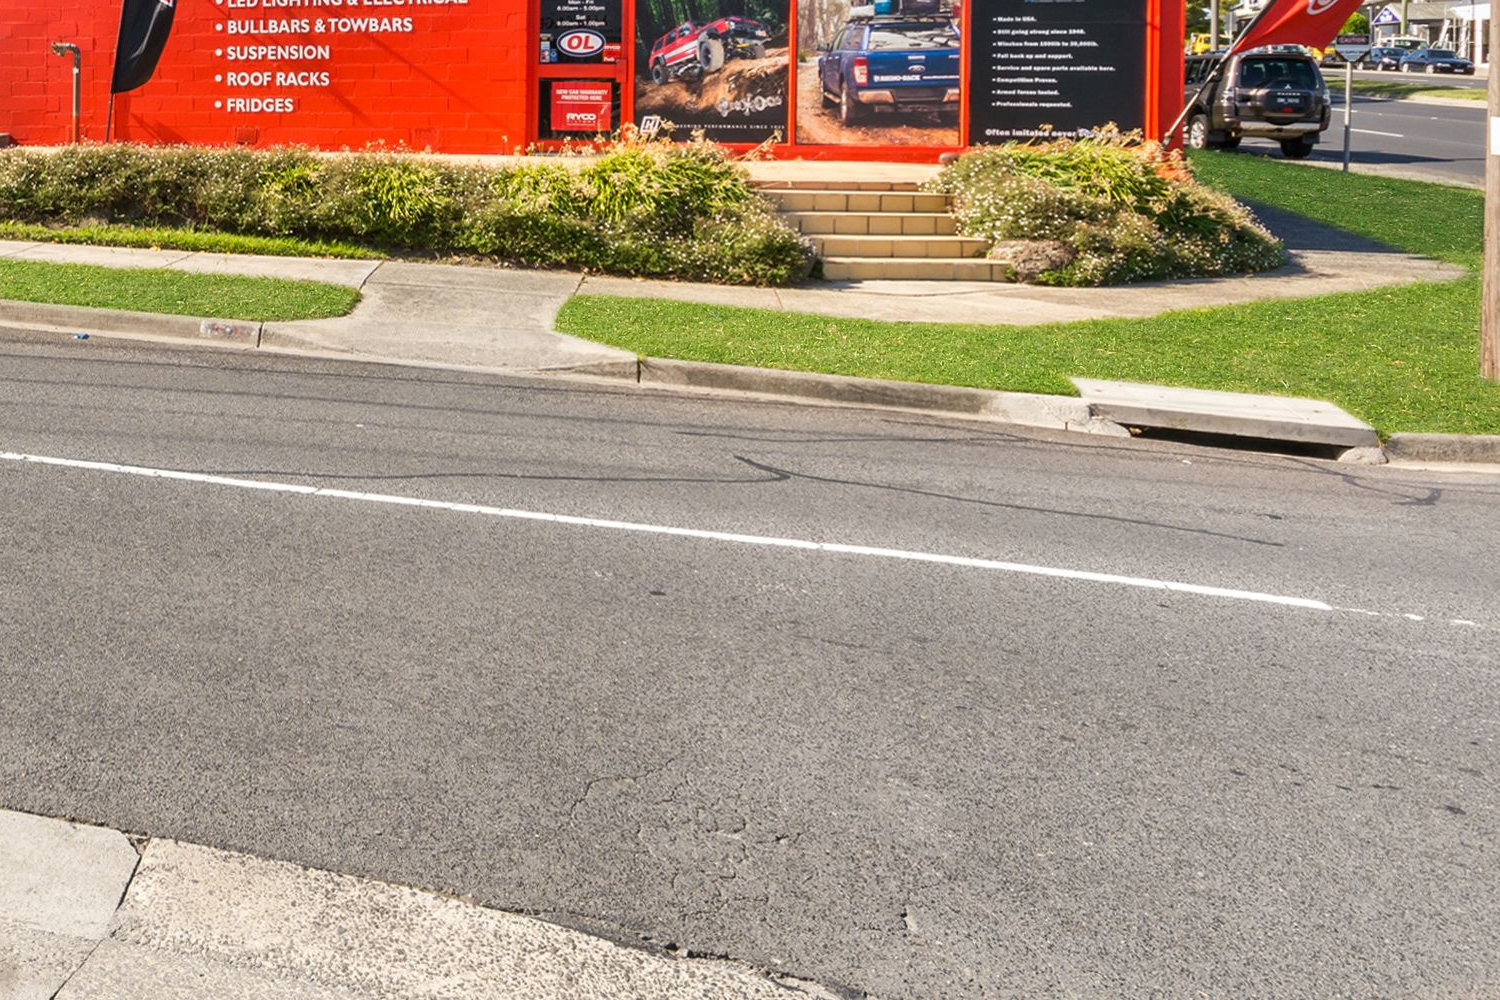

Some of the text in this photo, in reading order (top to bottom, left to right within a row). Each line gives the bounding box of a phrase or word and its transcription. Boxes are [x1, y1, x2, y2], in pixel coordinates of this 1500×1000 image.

[227, 17, 413, 34] BULLBARS & TOWBARS
[566, 35, 595, 51] OL
[227, 45, 330, 60] SUSPENSION
[227, 71, 330, 87] ROOF RACKS
[227, 98, 294, 113] FRIDGES
[985, 128, 1010, 136] Often
